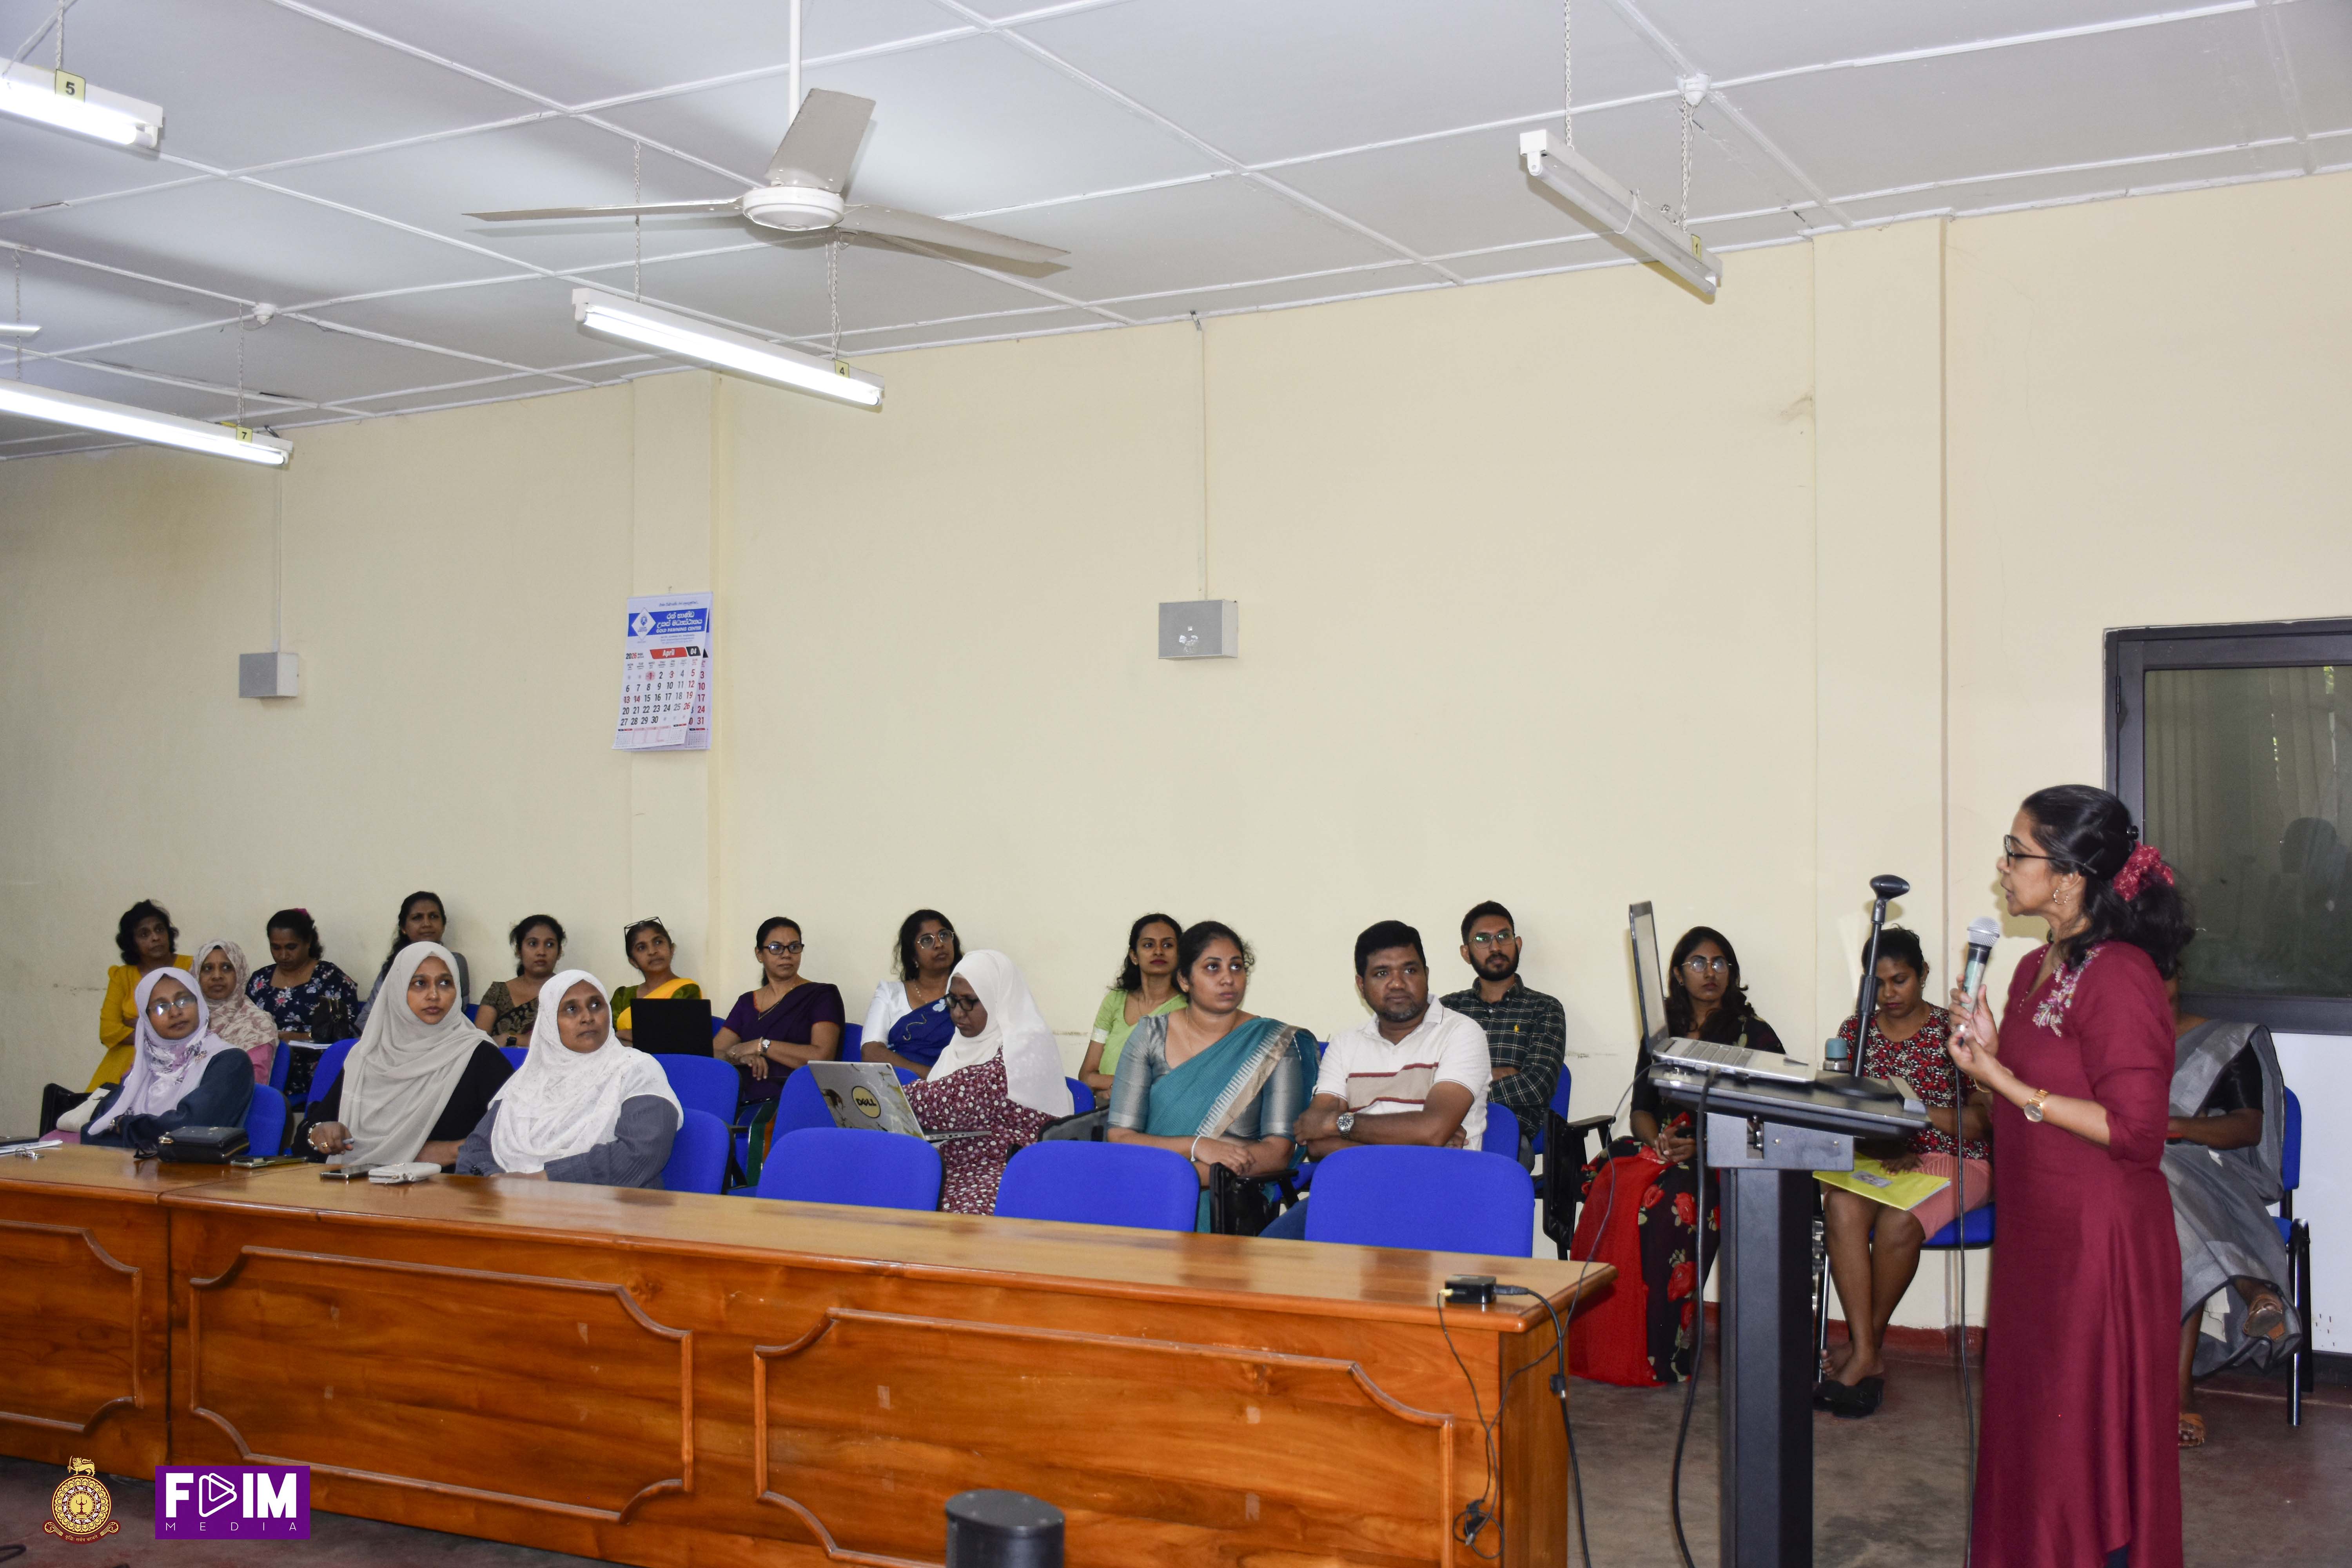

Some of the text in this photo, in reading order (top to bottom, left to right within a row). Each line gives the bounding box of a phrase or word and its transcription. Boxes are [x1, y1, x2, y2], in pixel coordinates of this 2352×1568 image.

[66, 81, 75, 95] 5
[840, 367, 845, 376] 4
[662, 649, 675, 657] April
[666, 693, 672, 701] 17
